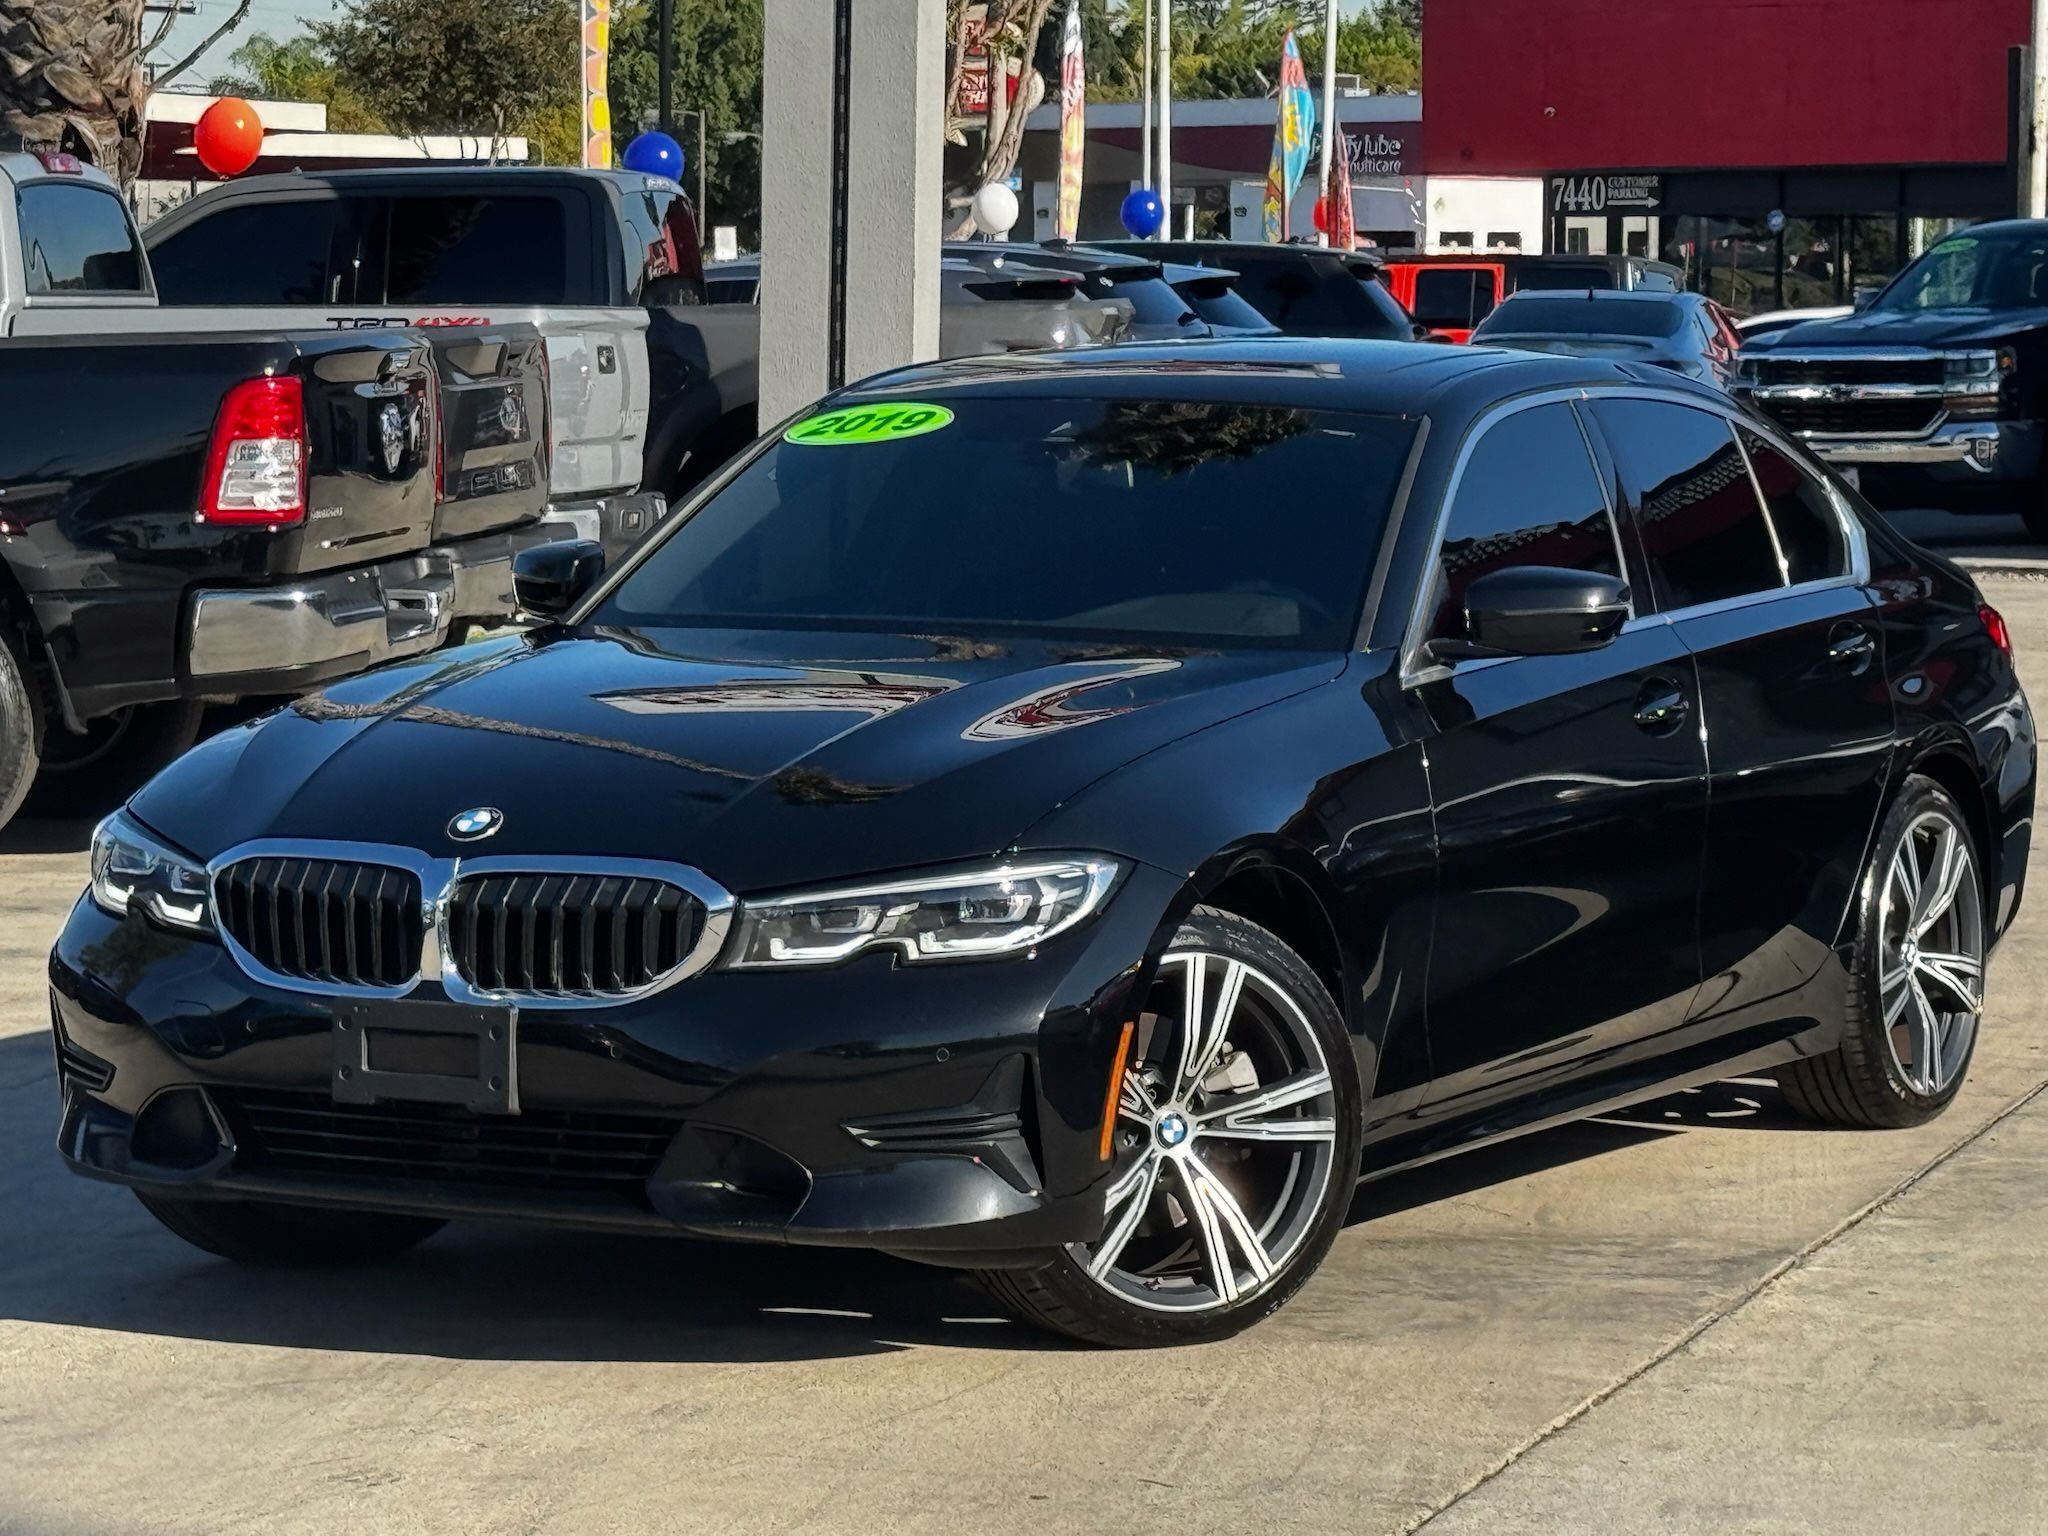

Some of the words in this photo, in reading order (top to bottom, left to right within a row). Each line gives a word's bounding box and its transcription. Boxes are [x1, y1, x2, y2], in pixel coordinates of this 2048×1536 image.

[1364, 134, 1402, 156] lube
[1552, 176, 1606, 211] 7440
[797, 411, 937, 439] 2019
